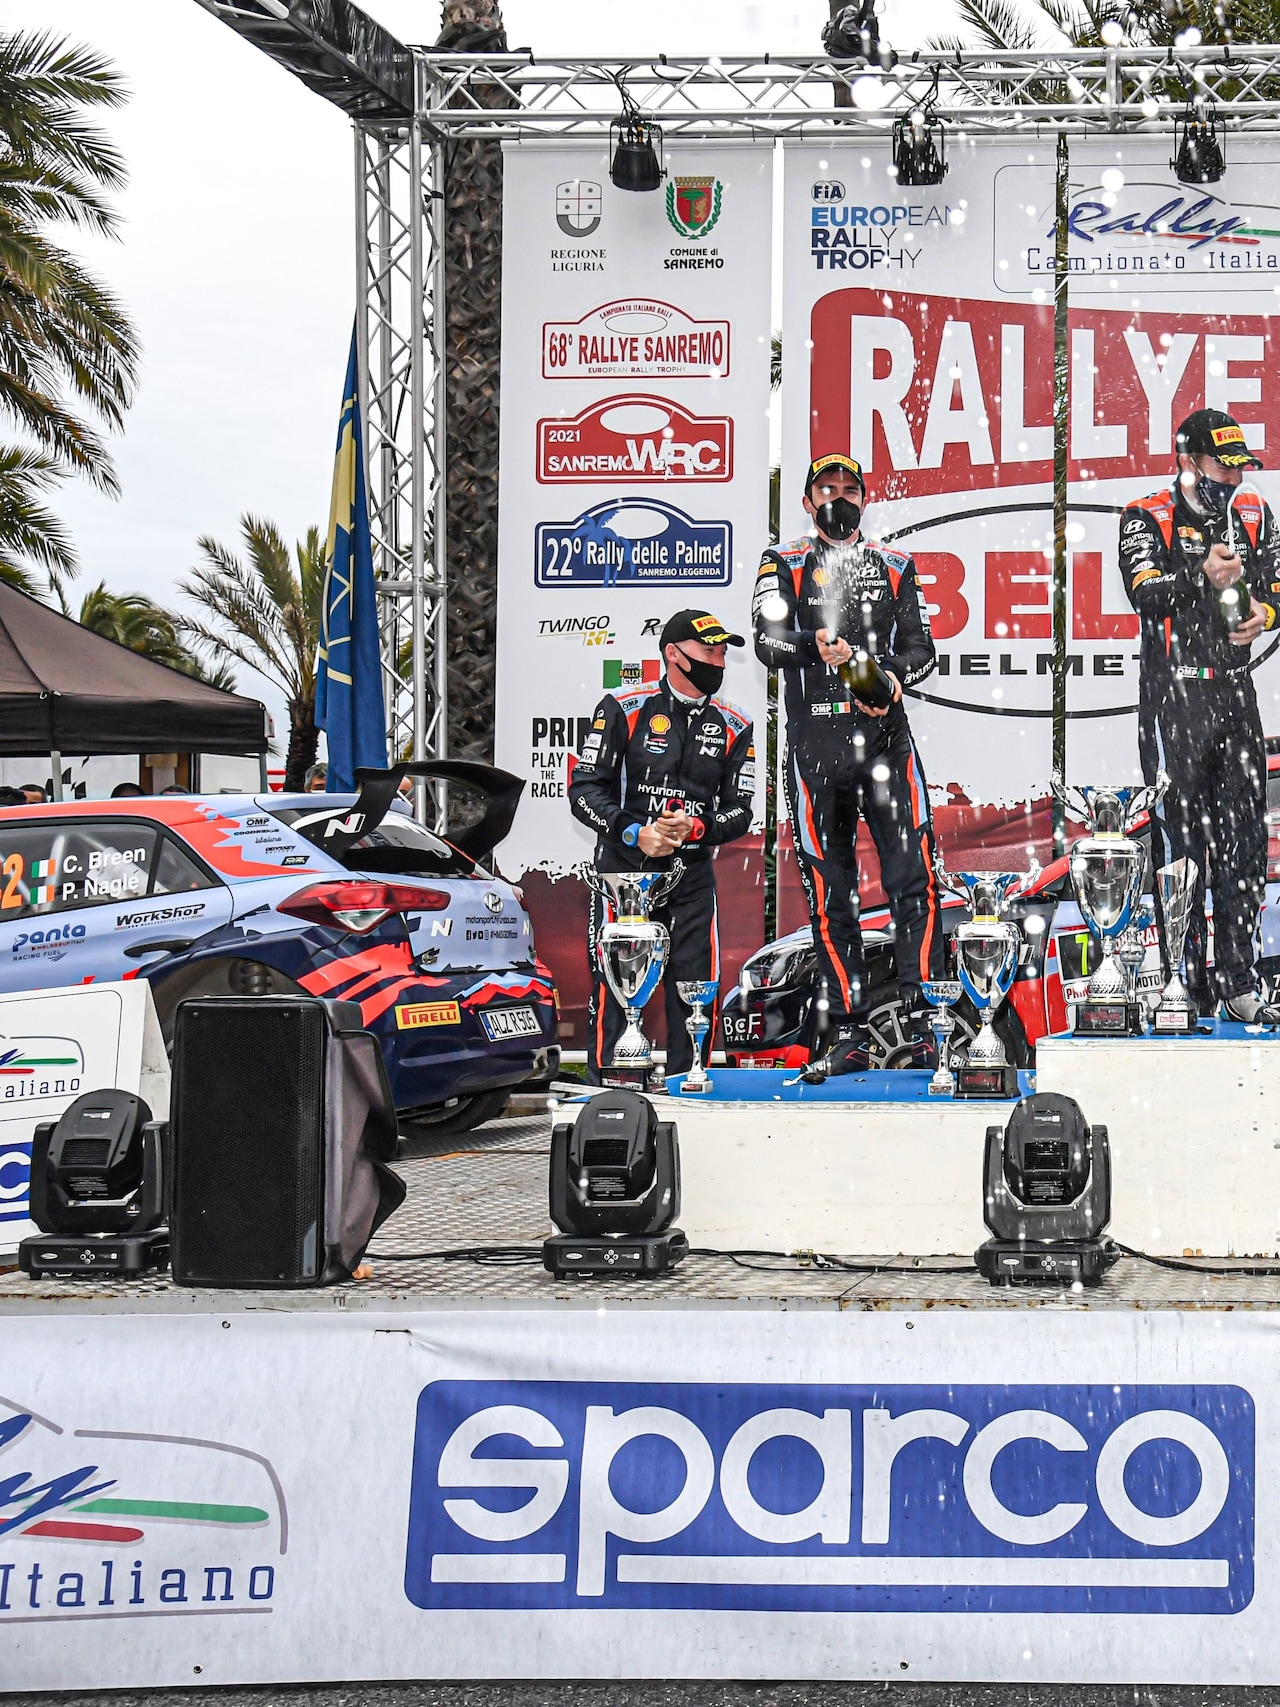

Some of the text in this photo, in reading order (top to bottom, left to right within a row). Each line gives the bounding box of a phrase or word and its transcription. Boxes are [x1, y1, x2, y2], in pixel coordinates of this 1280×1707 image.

[811, 206, 961, 226] EUROPEAN
[1047, 196, 1248, 252] Rally
[811, 228, 898, 248] RALLY
[550, 249, 607, 259] REGIONE
[670, 248, 719, 256] COMUNE di
[811, 248, 922, 270] TROPHY
[1027, 247, 1186, 274] Campionato
[552, 262, 605, 272] LIGURIA
[663, 258, 724, 270] SANREMO
[579, 336, 638, 365] RALLYE
[644, 330, 723, 367] SANREMO
[848, 312, 1265, 474] RALLYE
[548, 430, 581, 442] 2021
[625, 438, 721, 476] WRC
[586, 541, 625, 571] Rally
[632, 542, 668, 565] delle
[675, 540, 722, 565] Palme
[638, 567, 721, 577] SANREMO LEGGENDA
[539, 616, 610, 634] TWINGO
[619, 669, 643, 678] RALLYE
[812, 704, 832, 714] OMP
[532, 752, 564, 768] PLAY
[541, 770, 556, 780] THE
[531, 783, 564, 798] RACE
[247, 818, 270, 826] OMP
[63, 848, 146, 875] C. Breen
[62, 874, 140, 901] P. Nagle
[13, 949, 62, 962] RACING FUEL
[403, 1003, 457, 1026] PIRELLI
[490, 1013, 513, 1035] ALZ
[726, 1033, 760, 1042] ITALIA
[437, 1402, 1231, 1598] sparco
